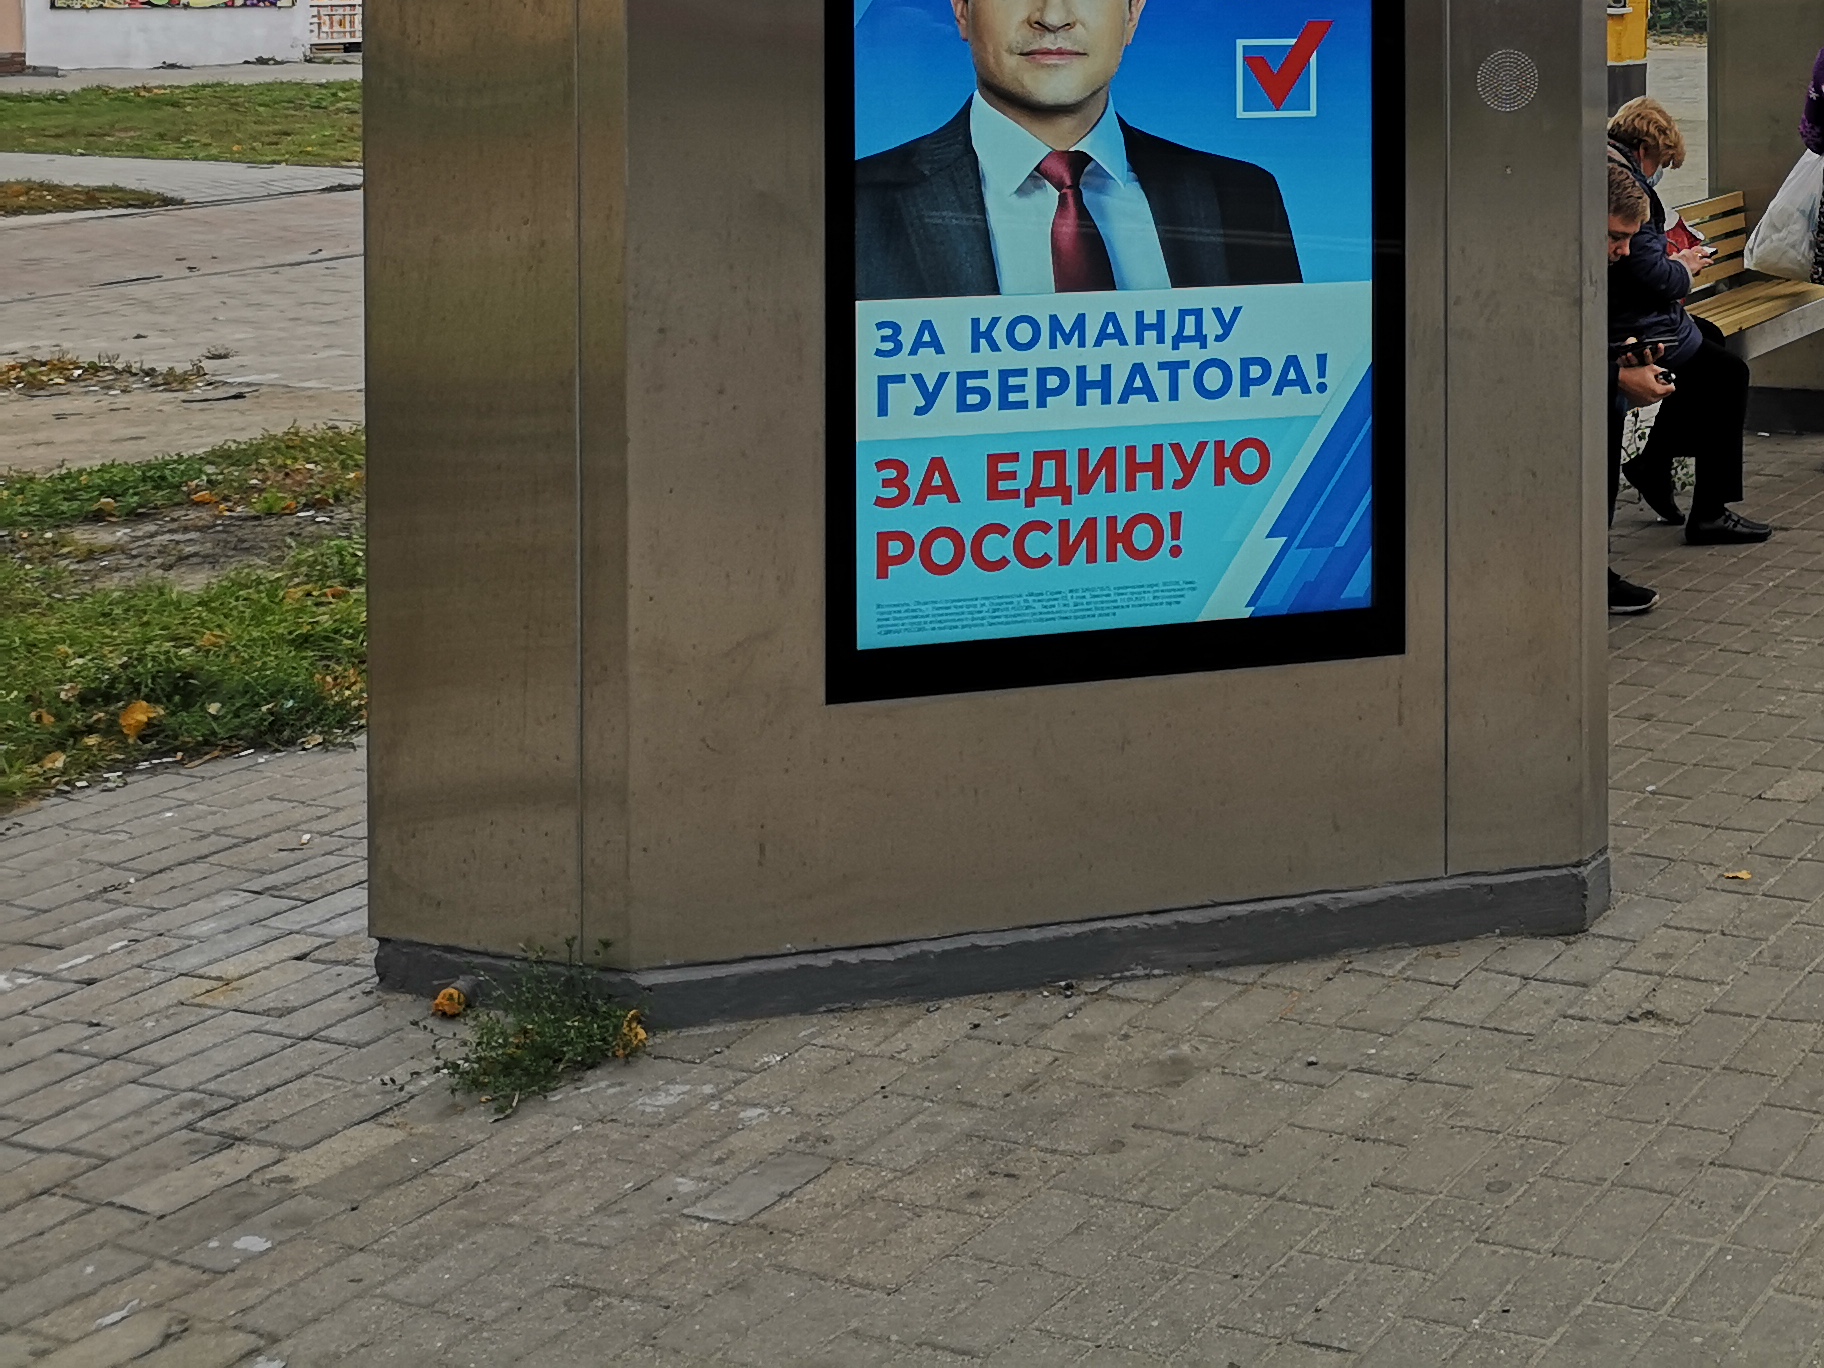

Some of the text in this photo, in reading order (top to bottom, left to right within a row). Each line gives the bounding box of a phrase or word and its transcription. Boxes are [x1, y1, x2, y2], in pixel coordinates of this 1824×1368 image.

[873, 305, 1243, 358] ЗА КОМАНДУ
[876, 352, 1329, 418] ГУБЕРНАТОРА!
[873, 437, 1272, 509] ЗА ЕДИНУЮ
[875, 510, 1183, 580] РОССИЮ!
